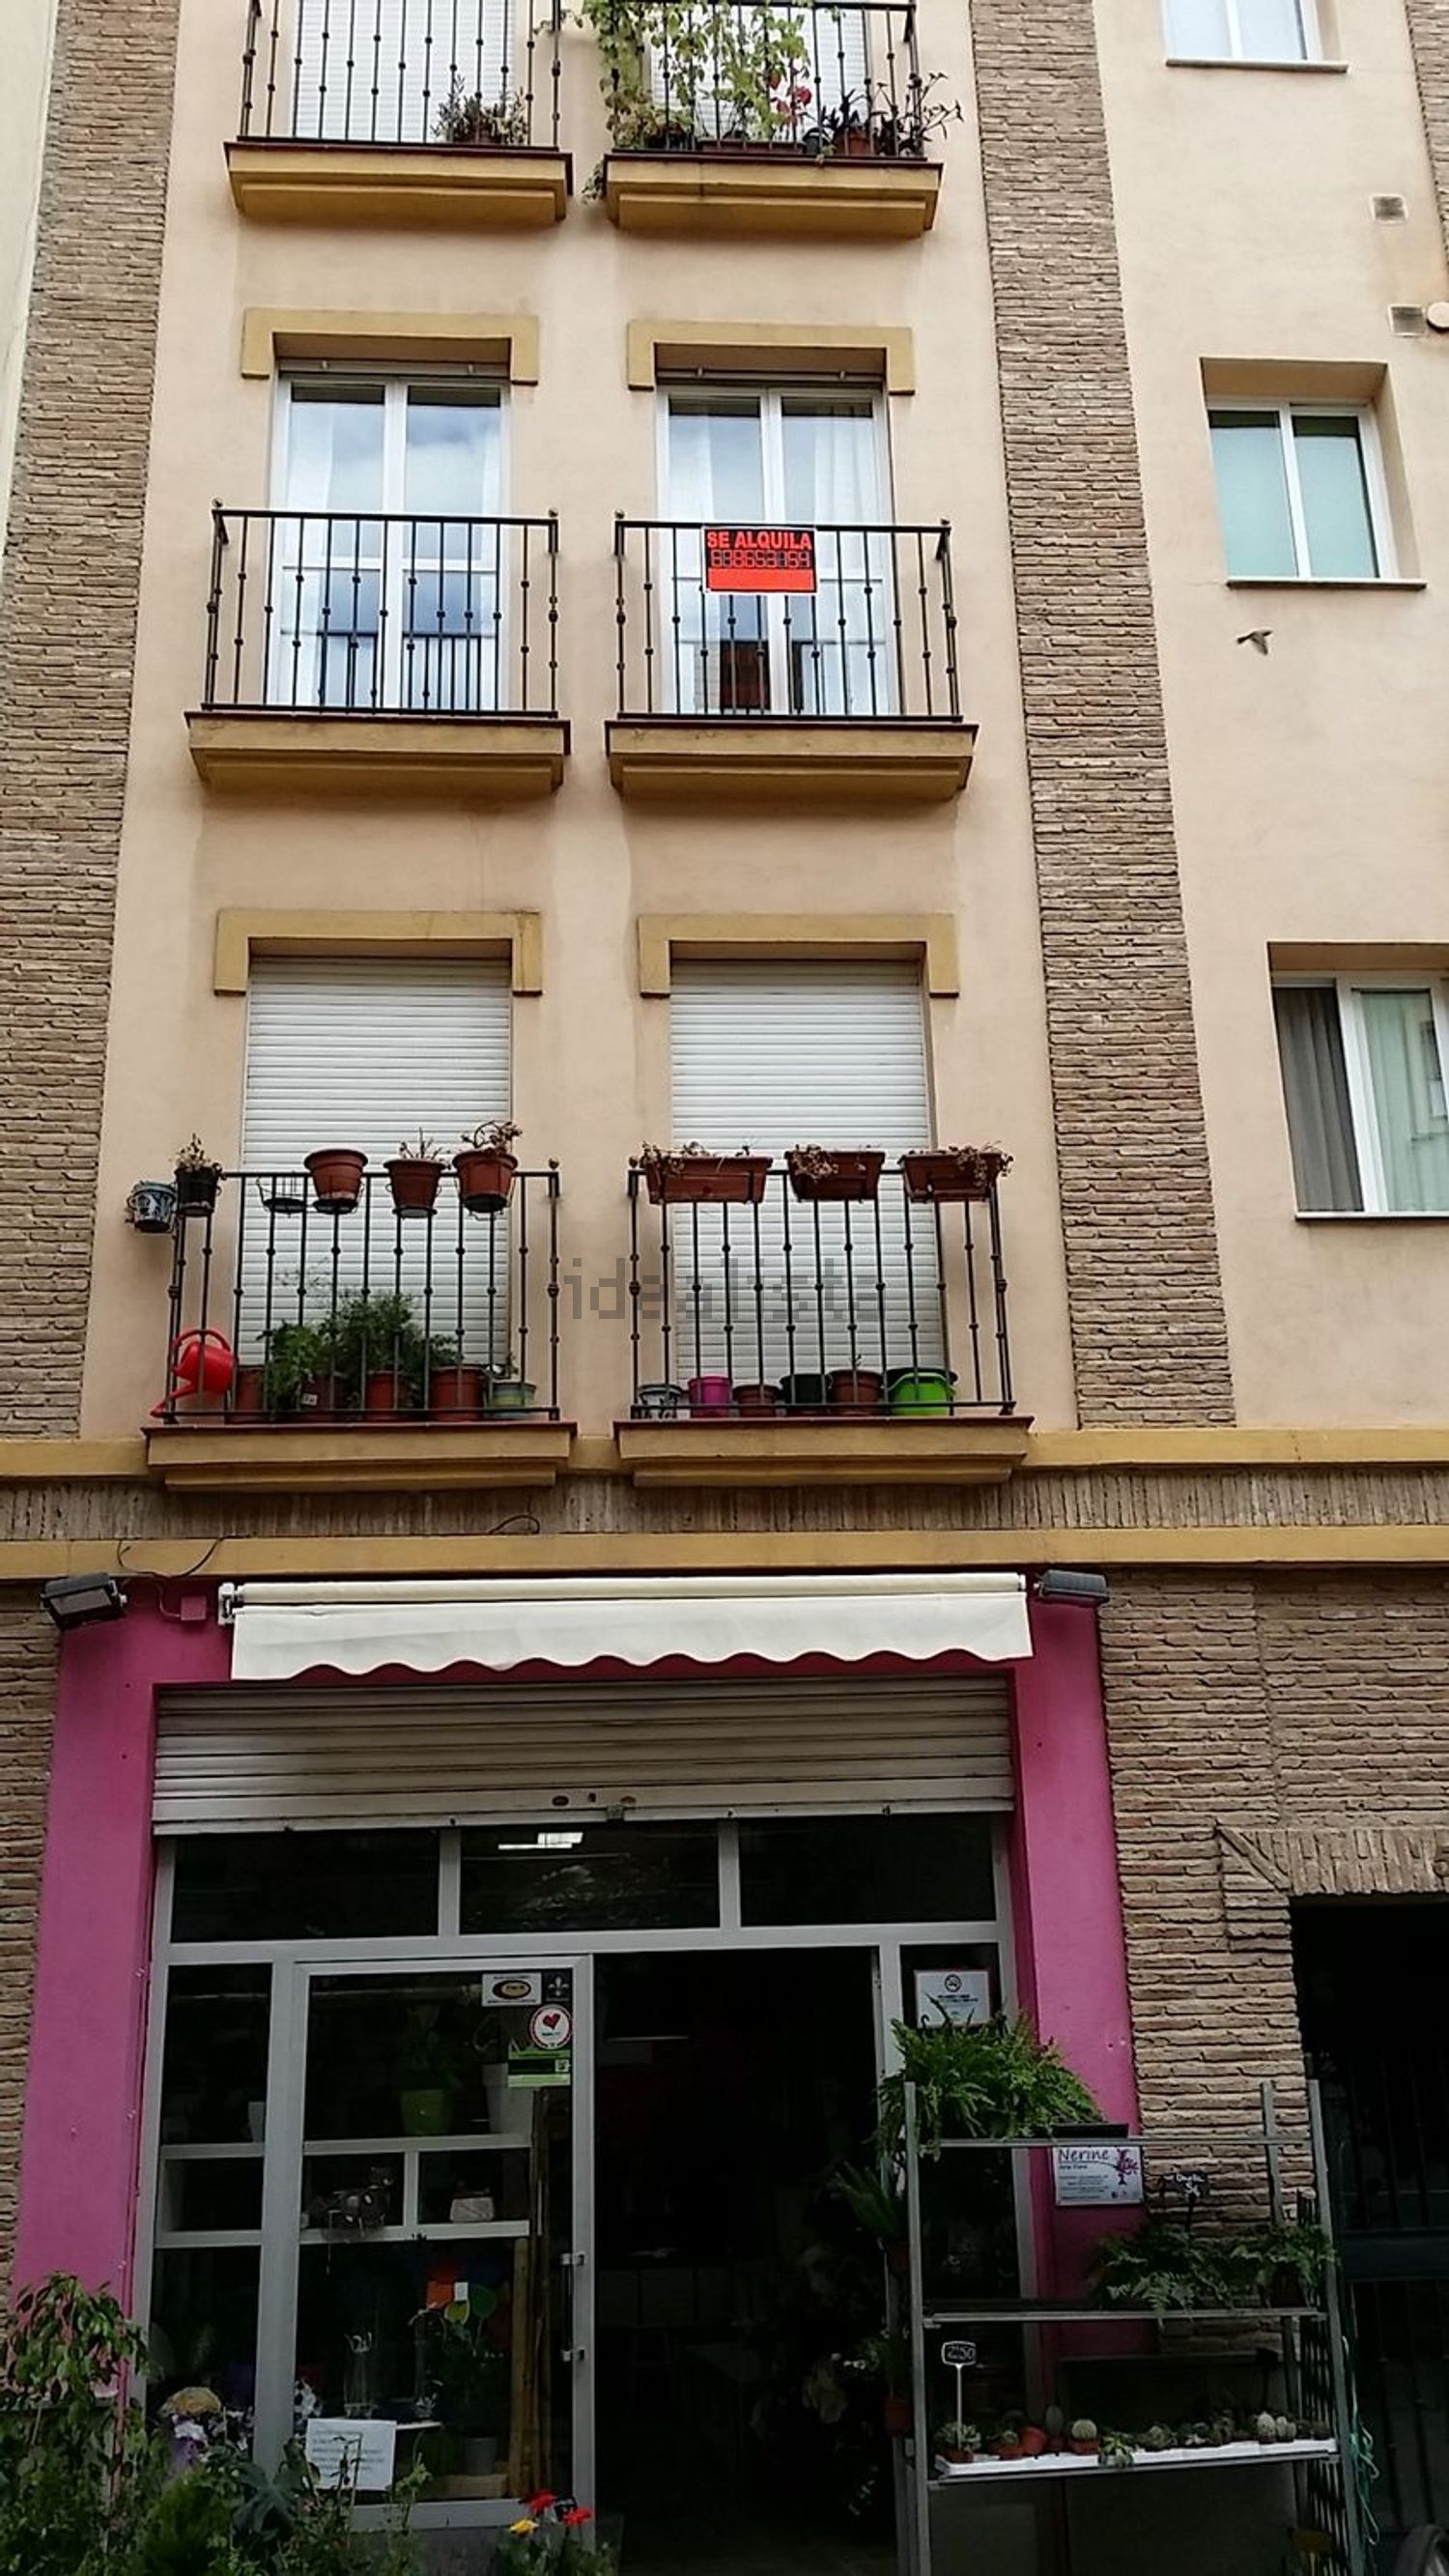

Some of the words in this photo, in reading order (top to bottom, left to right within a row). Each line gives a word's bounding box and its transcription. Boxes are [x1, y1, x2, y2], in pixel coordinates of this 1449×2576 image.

[707, 531, 729, 548] SE
[734, 531, 812, 550] ALQUILA
[1059, 2147, 1109, 2161] Nerine
